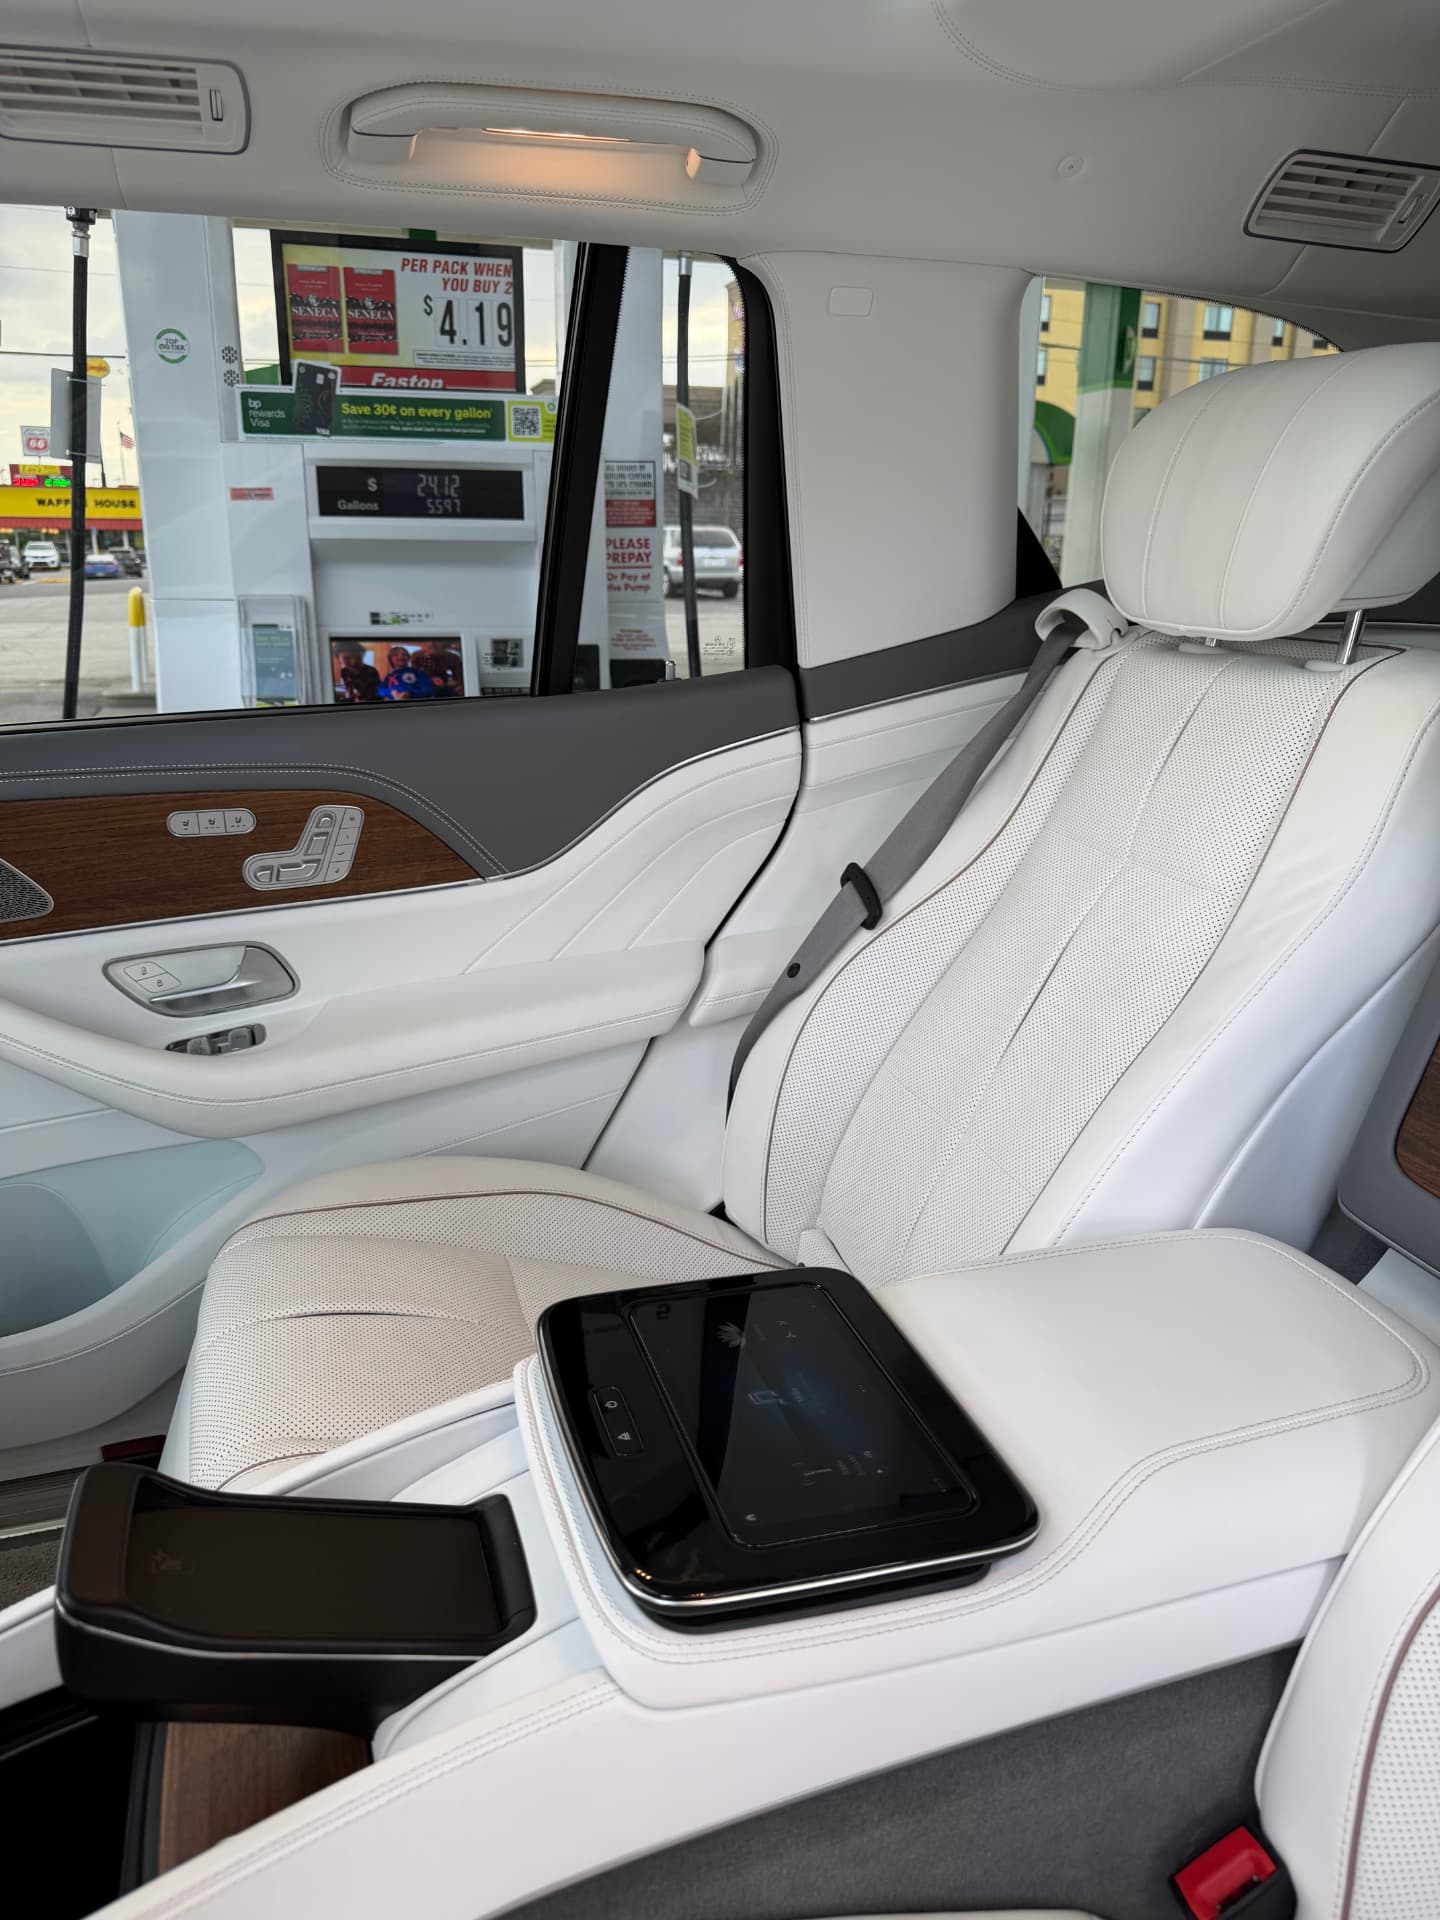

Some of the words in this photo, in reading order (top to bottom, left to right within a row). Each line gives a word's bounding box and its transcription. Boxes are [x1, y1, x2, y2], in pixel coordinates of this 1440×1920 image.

[401, 258, 428, 273] PER
[432, 260, 469, 275] PACK
[474, 262, 512, 278] WHEN
[442, 277, 469, 292] YOU
[473, 279, 500, 294] BUY
[504, 281, 512, 295] 2
[292, 305, 339, 318] SENECA
[347, 308, 394, 321] SENECA
[248, 398, 262, 409] bp
[249, 409, 286, 418] rewards
[341, 402, 371, 415] Save
[373, 404, 397, 416] 30¢
[400, 406, 416, 417] on
[418, 408, 451, 420] every
[250, 418, 271, 427] Visa
[29, 438, 45, 449] 66
[367, 477, 378, 492] $
[95, 498, 136, 509] HOUSE
[337, 499, 379, 511] Gallons
[606, 537, 651, 550] PLEASE
[606, 552, 652, 564] PREPAY
